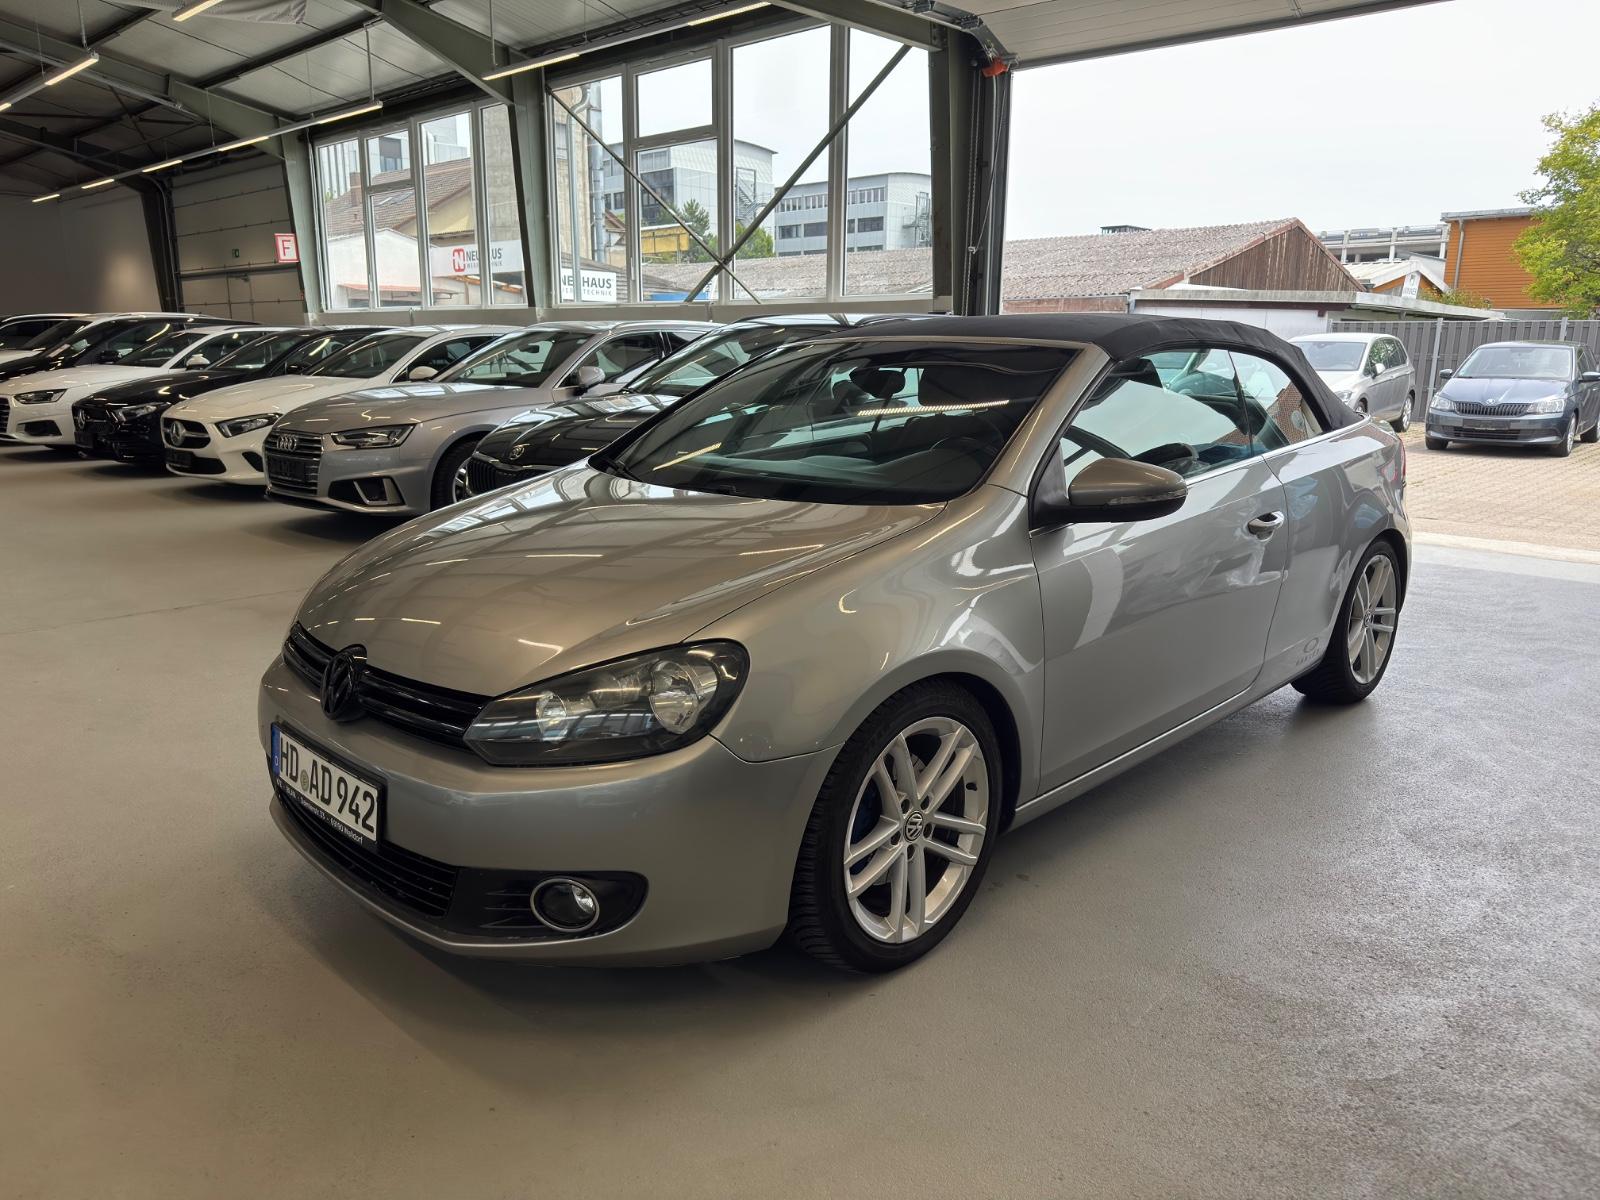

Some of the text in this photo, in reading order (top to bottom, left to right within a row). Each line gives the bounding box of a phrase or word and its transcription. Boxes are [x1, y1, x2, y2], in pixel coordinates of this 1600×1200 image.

[282, 240, 291, 256] F
[466, 248, 502, 261] NEUUS
[562, 275, 612, 289] NEHAUS
[280, 737, 299, 783] HD
[309, 759, 332, 806] AD
[337, 776, 375, 834] 942
